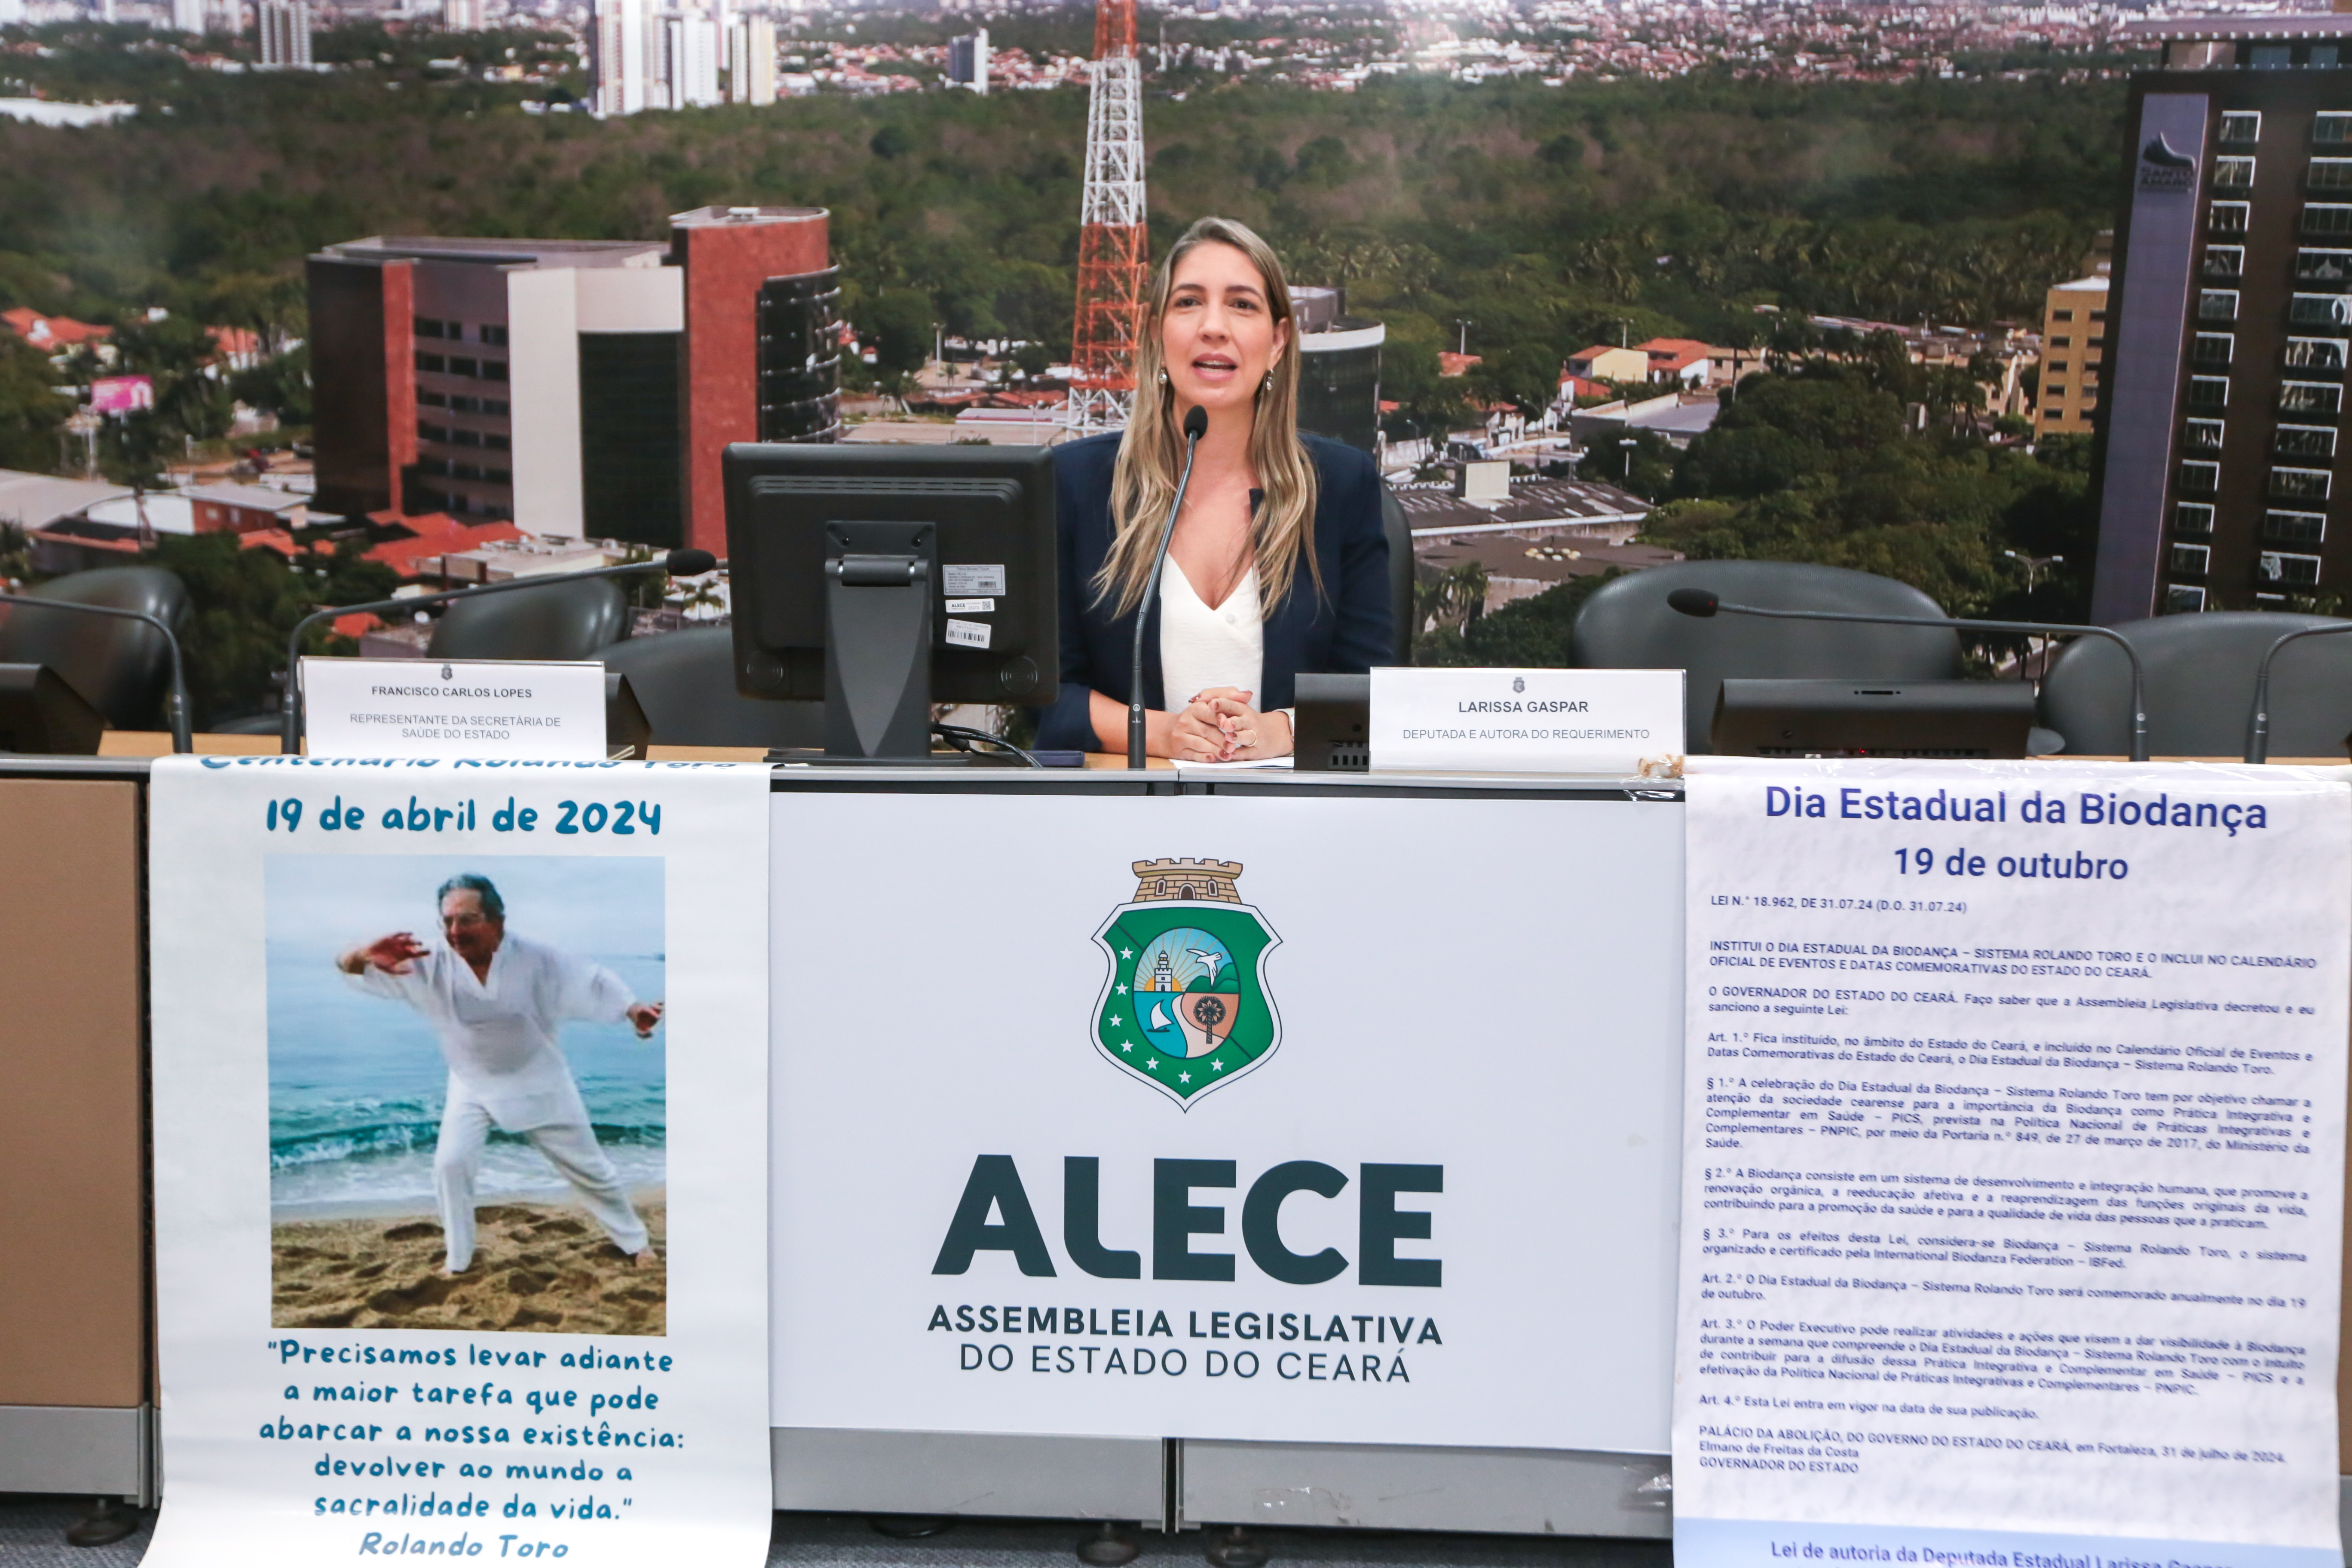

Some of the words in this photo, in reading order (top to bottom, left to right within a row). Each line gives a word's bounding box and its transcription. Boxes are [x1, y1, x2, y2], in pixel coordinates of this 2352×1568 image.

[372, 686, 438, 695] FRANCISCO
[443, 688, 490, 697] CARLOS
[494, 689, 532, 698] LOPES
[1459, 701, 1522, 712] LARISSA
[1527, 701, 1588, 712] GASPAR
[350, 714, 447, 724] REPRESENTANTE
[452, 716, 467, 724] DA
[471, 716, 542, 726] SECRETÁRIA
[546, 717, 560, 726] DE
[402, 729, 440, 738] SAÚDE
[444, 729, 460, 738] DO
[465, 730, 509, 739] ESTADO
[1403, 730, 1466, 738] DEPUTADA
[1470, 730, 1476, 738] E
[1480, 730, 1528, 738] AUTORA
[1532, 730, 1549, 738] DO
[1553, 729, 1649, 738] REQUERIMENTO
[267, 798, 302, 832] 19
[320, 796, 364, 830] de
[382, 796, 475, 832] abril
[493, 796, 537, 831] de
[556, 800, 660, 835] 2024
[1767, 786, 1825, 818] Dia
[1841, 788, 2005, 822] Estadual
[2021, 791, 2065, 823] da
[2081, 793, 2266, 837] Biodança
[1895, 848, 1933, 874] 19
[1946, 848, 1985, 876] de
[1998, 851, 2128, 879] outubro
[1712, 895, 1728, 905] LEI
[1754, 897, 1797, 909] 18.962,
[1801, 898, 1817, 908] DE
[1820, 898, 1873, 910] 31.07.24
[1877, 900, 1906, 912] (D.O.
[1909, 901, 1967, 914] 31.07.24)
[1710, 956, 1755, 966] OFICIAL
[1760, 958, 1775, 967] DE
[1779, 958, 1835, 969] EVENTOS
[1840, 960, 1846, 969] E
[1851, 960, 1892, 971] DATAS
[1896, 962, 2007, 974] COMEMORATIVAS
[2012, 965, 2027, 974] DO
[2032, 965, 2080, 976] ESTADO
[2085, 967, 2101, 976] DO
[2107, 967, 2151, 977] CEARÁ.
[1711, 941, 1761, 951] INSTITUI
[1766, 942, 1774, 952] O
[1779, 943, 1798, 952] DIA
[1804, 943, 1867, 954] ESTADUAL
[1872, 946, 1888, 955] DA
[1893, 946, 1957, 959] BIODANÇA
[1975, 949, 2029, 959] SISTEMA
[2034, 950, 2092, 960] ROLANDO
[2098, 951, 2132, 962] TORO
[2137, 953, 2143, 962] E
[2148, 953, 2156, 962] O
[2162, 954, 2202, 964] INCLUI
[2208, 956, 2226, 965] NO
[2232, 956, 2316, 968] CALENDÁRIO
[1709, 986, 1717, 996] O
[1723, 986, 1807, 998] GOVERNADOR
[1813, 989, 1829, 999] DO
[1836, 990, 1884, 1001] ESTADO
[1891, 992, 1908, 1001] DO
[1914, 992, 1957, 1002] CEARÁ.
[1965, 994, 1992, 1005] Faço
[1999, 996, 2030, 1004] saber
[2037, 998, 2058, 1007] que
[2077, 997, 2146, 1008] Assembleia
[2152, 1000, 2218, 1011] Legislativa
[2225, 1004, 2279, 1013] decretou
[1774, 1006, 1824, 1015] seguinte
[931, 1155, 1443, 1287] ALECE
[1702, 1289, 1715, 1298] de
[928, 1305, 1173, 1337] ASSEMBLEIA
[1190, 1311, 1442, 1344] LEGISLATIVA
[269, 1339, 456, 1366] "Precisamos
[470, 1344, 546, 1367] levar
[561, 1345, 672, 1372] adiante
[961, 1344, 1013, 1371] DO
[1032, 1346, 1186, 1376] ESTADO
[1207, 1351, 1259, 1378] DO
[1277, 1352, 1409, 1382] CEARÁ
[285, 1386, 299, 1399] a
[314, 1382, 398, 1402] maior
[413, 1383, 511, 1405] tarefa
[527, 1390, 577, 1414] que
[591, 1386, 658, 1417] pode
[1700, 1395, 1718, 1404] Art.
[1745, 1396, 1769, 1406] Esta
[1773, 1398, 1789, 1407] Lei
[1794, 1400, 1823, 1409] entra
[1850, 1404, 1877, 1413] vigor
[1900, 1403, 1925, 1413] data
[1929, 1404, 1943, 1414] de
[1972, 1406, 2038, 1420] publicação.
[260, 1416, 382, 1441] abarcar
[397, 1426, 411, 1440] a
[426, 1426, 509, 1444] nossa
[524, 1421, 683, 1448] existência:
[1700, 1441, 1743, 1452] Elmano
[1747, 1443, 1760, 1453] de
[1764, 1444, 1804, 1455] Freitas
[1808, 1446, 1821, 1455] da
[1825, 1447, 1859, 1457] Costa
[315, 1454, 445, 1477] devolver
[460, 1464, 492, 1478] ao
[507, 1460, 603, 1480] mundo
[617, 1468, 632, 1480] a
[1700, 1457, 1784, 1470] GOVERNADOR
[1789, 1461, 1805, 1470] DO
[1810, 1462, 1858, 1473] ESTADO
[315, 1492, 489, 1516] sacralidade
[504, 1494, 536, 1517] da
[551, 1495, 631, 1519] vida."
[359, 1532, 482, 1556] Rolando
[499, 1535, 568, 1557] Toro
[1772, 1542, 1796, 1557] Lei
[1803, 1542, 1823, 1558] de
[1830, 1546, 1890, 1561] autoria
[1897, 1546, 1917, 1562] da
[1923, 1547, 2007, 1568] Deputada
[2013, 1552, 2090, 1568] Estadual
